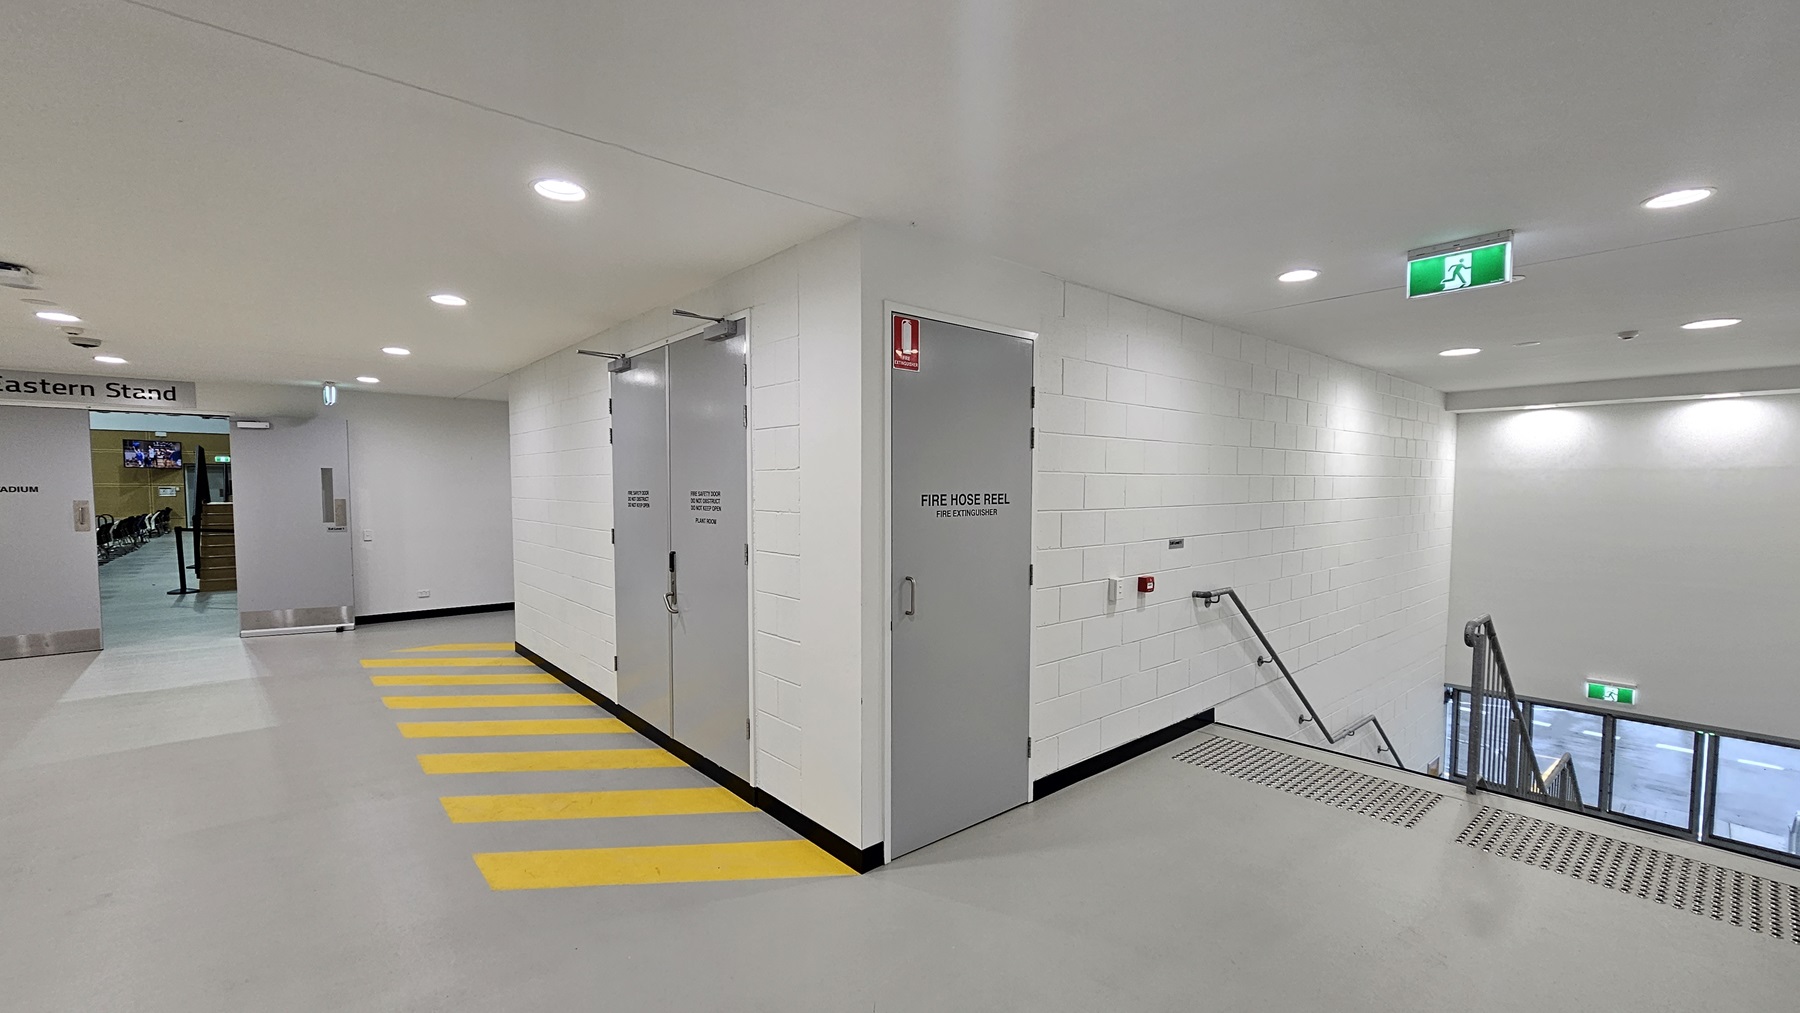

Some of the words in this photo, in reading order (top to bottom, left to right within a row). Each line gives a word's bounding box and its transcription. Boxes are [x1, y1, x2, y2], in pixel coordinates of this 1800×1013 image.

[0, 375, 95, 397] astern
[106, 382, 177, 401] Stand
[921, 494, 947, 507] FIRE
[951, 493, 981, 506] HOSE
[984, 493, 1010, 505] REEL
[936, 510, 951, 518] FIRE
[952, 508, 998, 518] EXTINGUISHER
